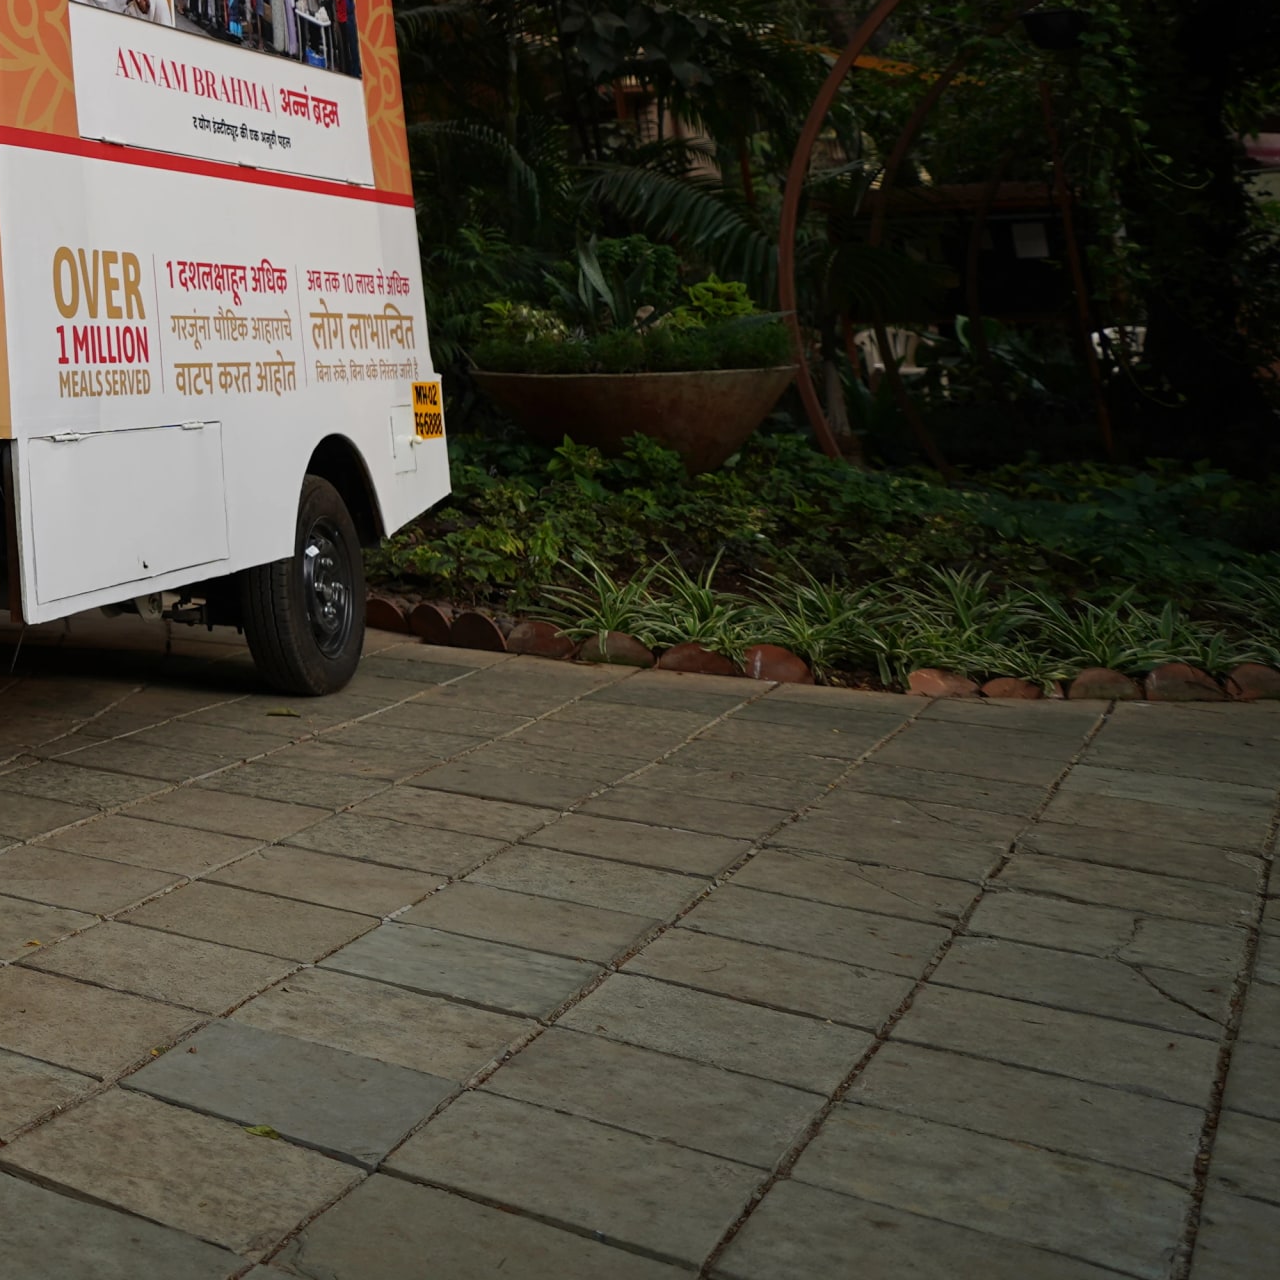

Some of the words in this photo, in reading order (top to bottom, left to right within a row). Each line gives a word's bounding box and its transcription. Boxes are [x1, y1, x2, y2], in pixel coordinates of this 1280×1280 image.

[115, 46, 189, 94] ANNAM
[192, 66, 272, 113] BRAHMA
[279, 85, 311, 121] अन्नं
[311, 95, 340, 129] ब्रह्म
[198, 114, 211, 132] योग
[240, 123, 248, 140] की
[249, 129, 259, 141] एक
[260, 130, 277, 149] अनूठी
[278, 135, 291, 149] पहल
[52, 246, 146, 319] OVER
[166, 260, 174, 289] 1
[177, 260, 248, 306] दशलक्षाहून
[251, 258, 287, 294] अधिक
[306, 270, 322, 292] अब
[323, 272, 340, 293] तक
[342, 273, 354, 294] 10
[355, 274, 376, 295] लाख
[377, 268, 385, 295] से
[386, 270, 410, 296] अधिक
[56, 325, 69, 365] 1
[72, 325, 149, 364] MILLION
[170, 308, 211, 350] गरजूंना
[213, 306, 249, 342] पौष्टिक
[251, 309, 292, 344] आहाराचे
[309, 298, 345, 350] लोग
[347, 303, 415, 350] लाभान्वित
[59, 370, 103, 398] MEALS
[105, 369, 151, 396] SERVED
[174, 362, 213, 396] वाटप
[217, 361, 251, 394] करत
[256, 350, 297, 396] आहोत
[315, 360, 332, 382] बिना
[349, 359, 365, 381] बिना
[366, 358, 378, 380] थके
[379, 358, 398, 380] निरंतर
[399, 358, 413, 380] जारी
[413, 356, 419, 381] है
